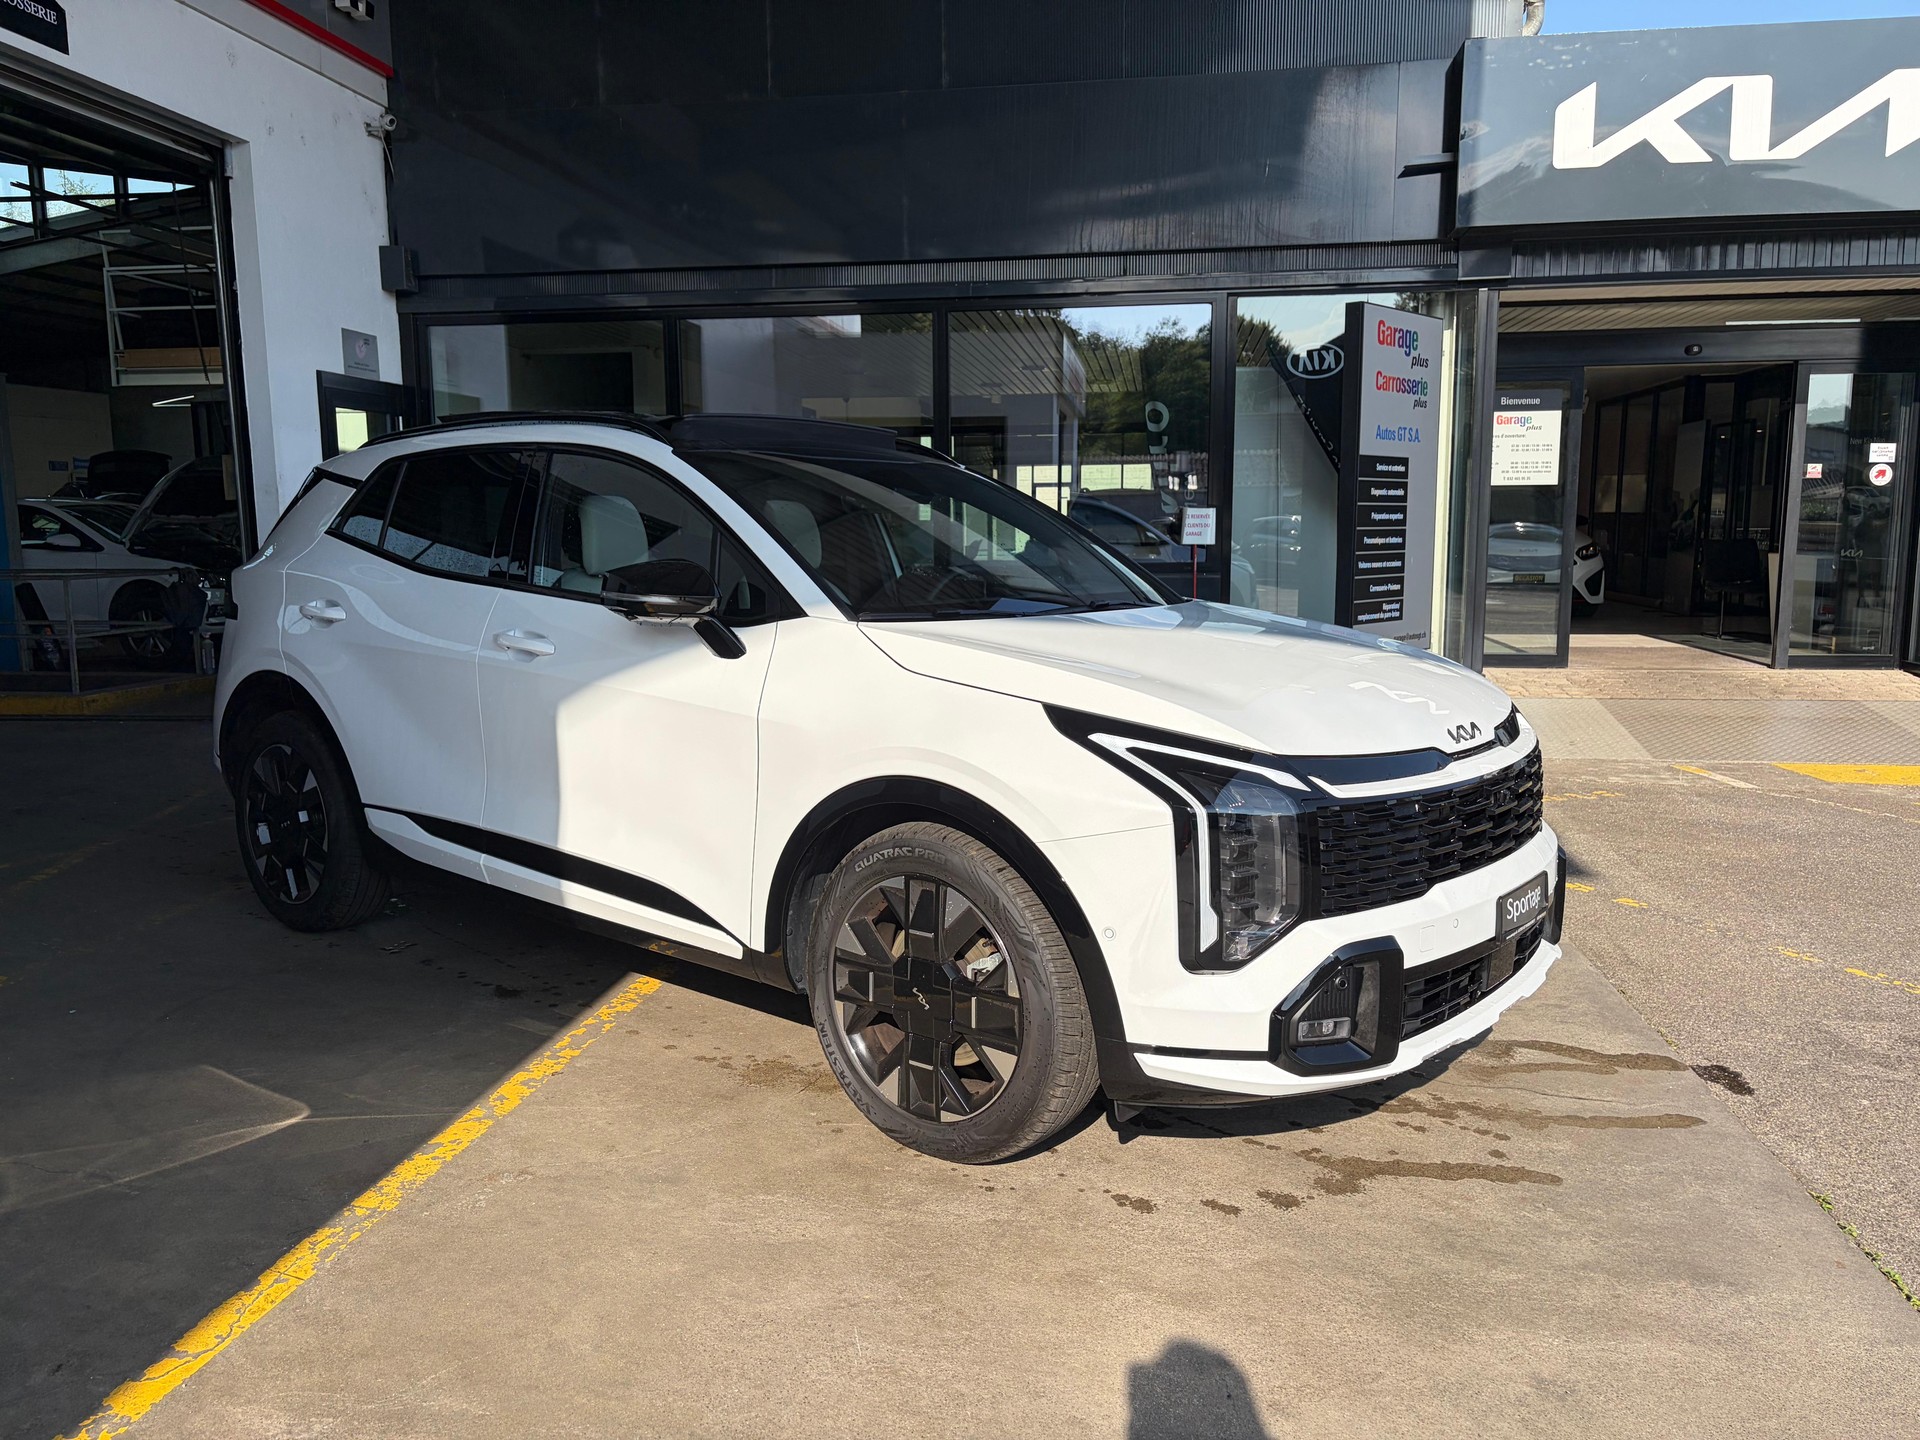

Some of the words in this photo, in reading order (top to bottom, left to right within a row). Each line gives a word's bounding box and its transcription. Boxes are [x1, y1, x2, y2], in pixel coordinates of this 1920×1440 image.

[1377, 319, 1419, 357] Garage
[1411, 353, 1429, 369] plus
[1375, 370, 1429, 397] Carrosserie
[1413, 397, 1428, 410] plus
[1500, 396, 1541, 406] Bienvenue
[1496, 414, 1533, 428] Garage
[1525, 424, 1543, 432] plus
[1375, 425, 1396, 441] Autos
[1397, 426, 1408, 442] GT
[1376, 463, 1388, 472] Service
[854, 846, 913, 872] QUATRAC
[1506, 885, 1541, 922] Sportage
